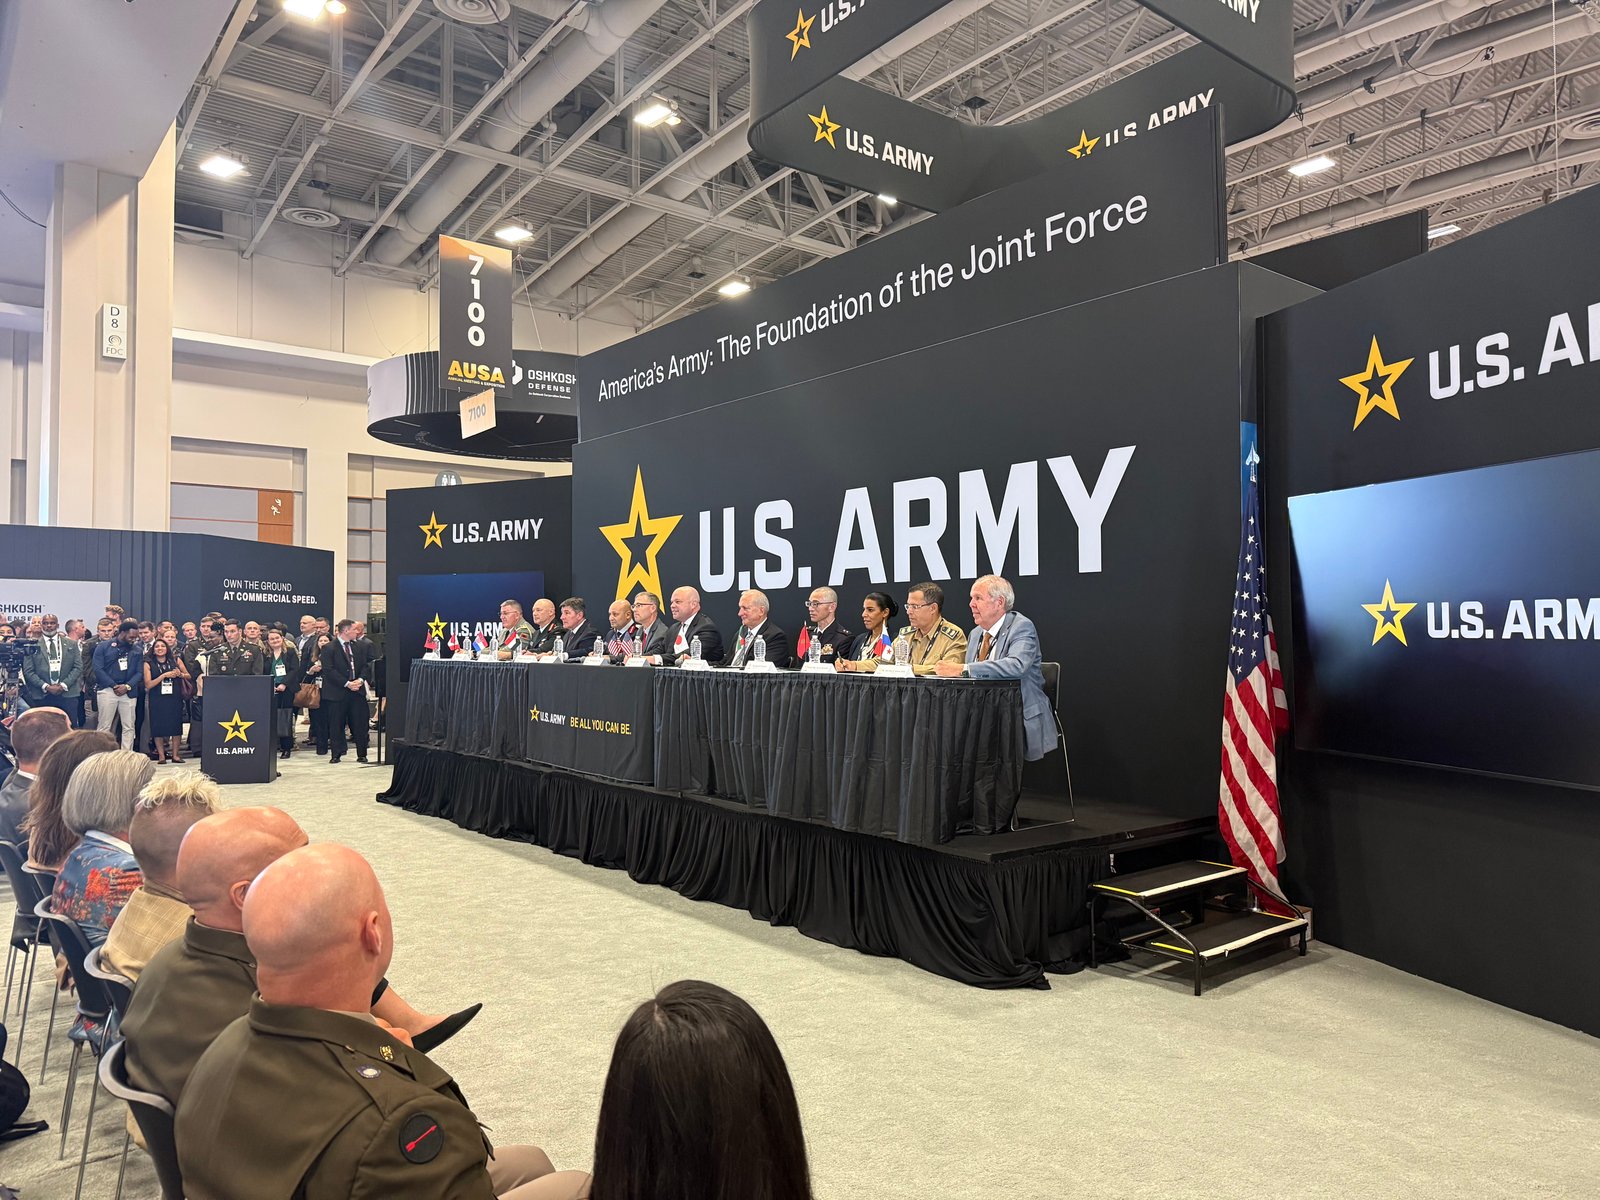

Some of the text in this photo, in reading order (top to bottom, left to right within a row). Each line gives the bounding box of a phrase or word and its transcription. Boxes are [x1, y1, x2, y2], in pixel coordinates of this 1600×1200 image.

[845, 127, 934, 176] U.S. ARMY
[467, 254, 486, 347] 7100
[598, 195, 1148, 402] America's Army: The Foundation of the Joint Force
[110, 306, 120, 316] D
[111, 318, 118, 328] 8
[106, 347, 123, 355] FDC
[1429, 302, 1600, 400] U.S. A
[448, 360, 505, 384] AUSA
[528, 382, 571, 392] DEFENSE
[468, 403, 487, 422] 7100
[700, 445, 1136, 592] U.S. ARMY
[452, 518, 543, 543] U.S. ARMY
[223, 578, 292, 592] OWN THE GROUND
[223, 591, 318, 604] AT COMMERCIAL SPEED.
[450, 621, 503, 637] U.S. ARM
[1426, 601, 1494, 639] U.S.
[540, 711, 632, 735] U.S. ARMY BE ALL YOU CAN BE.
[216, 747, 255, 755] U.S. ARMY
